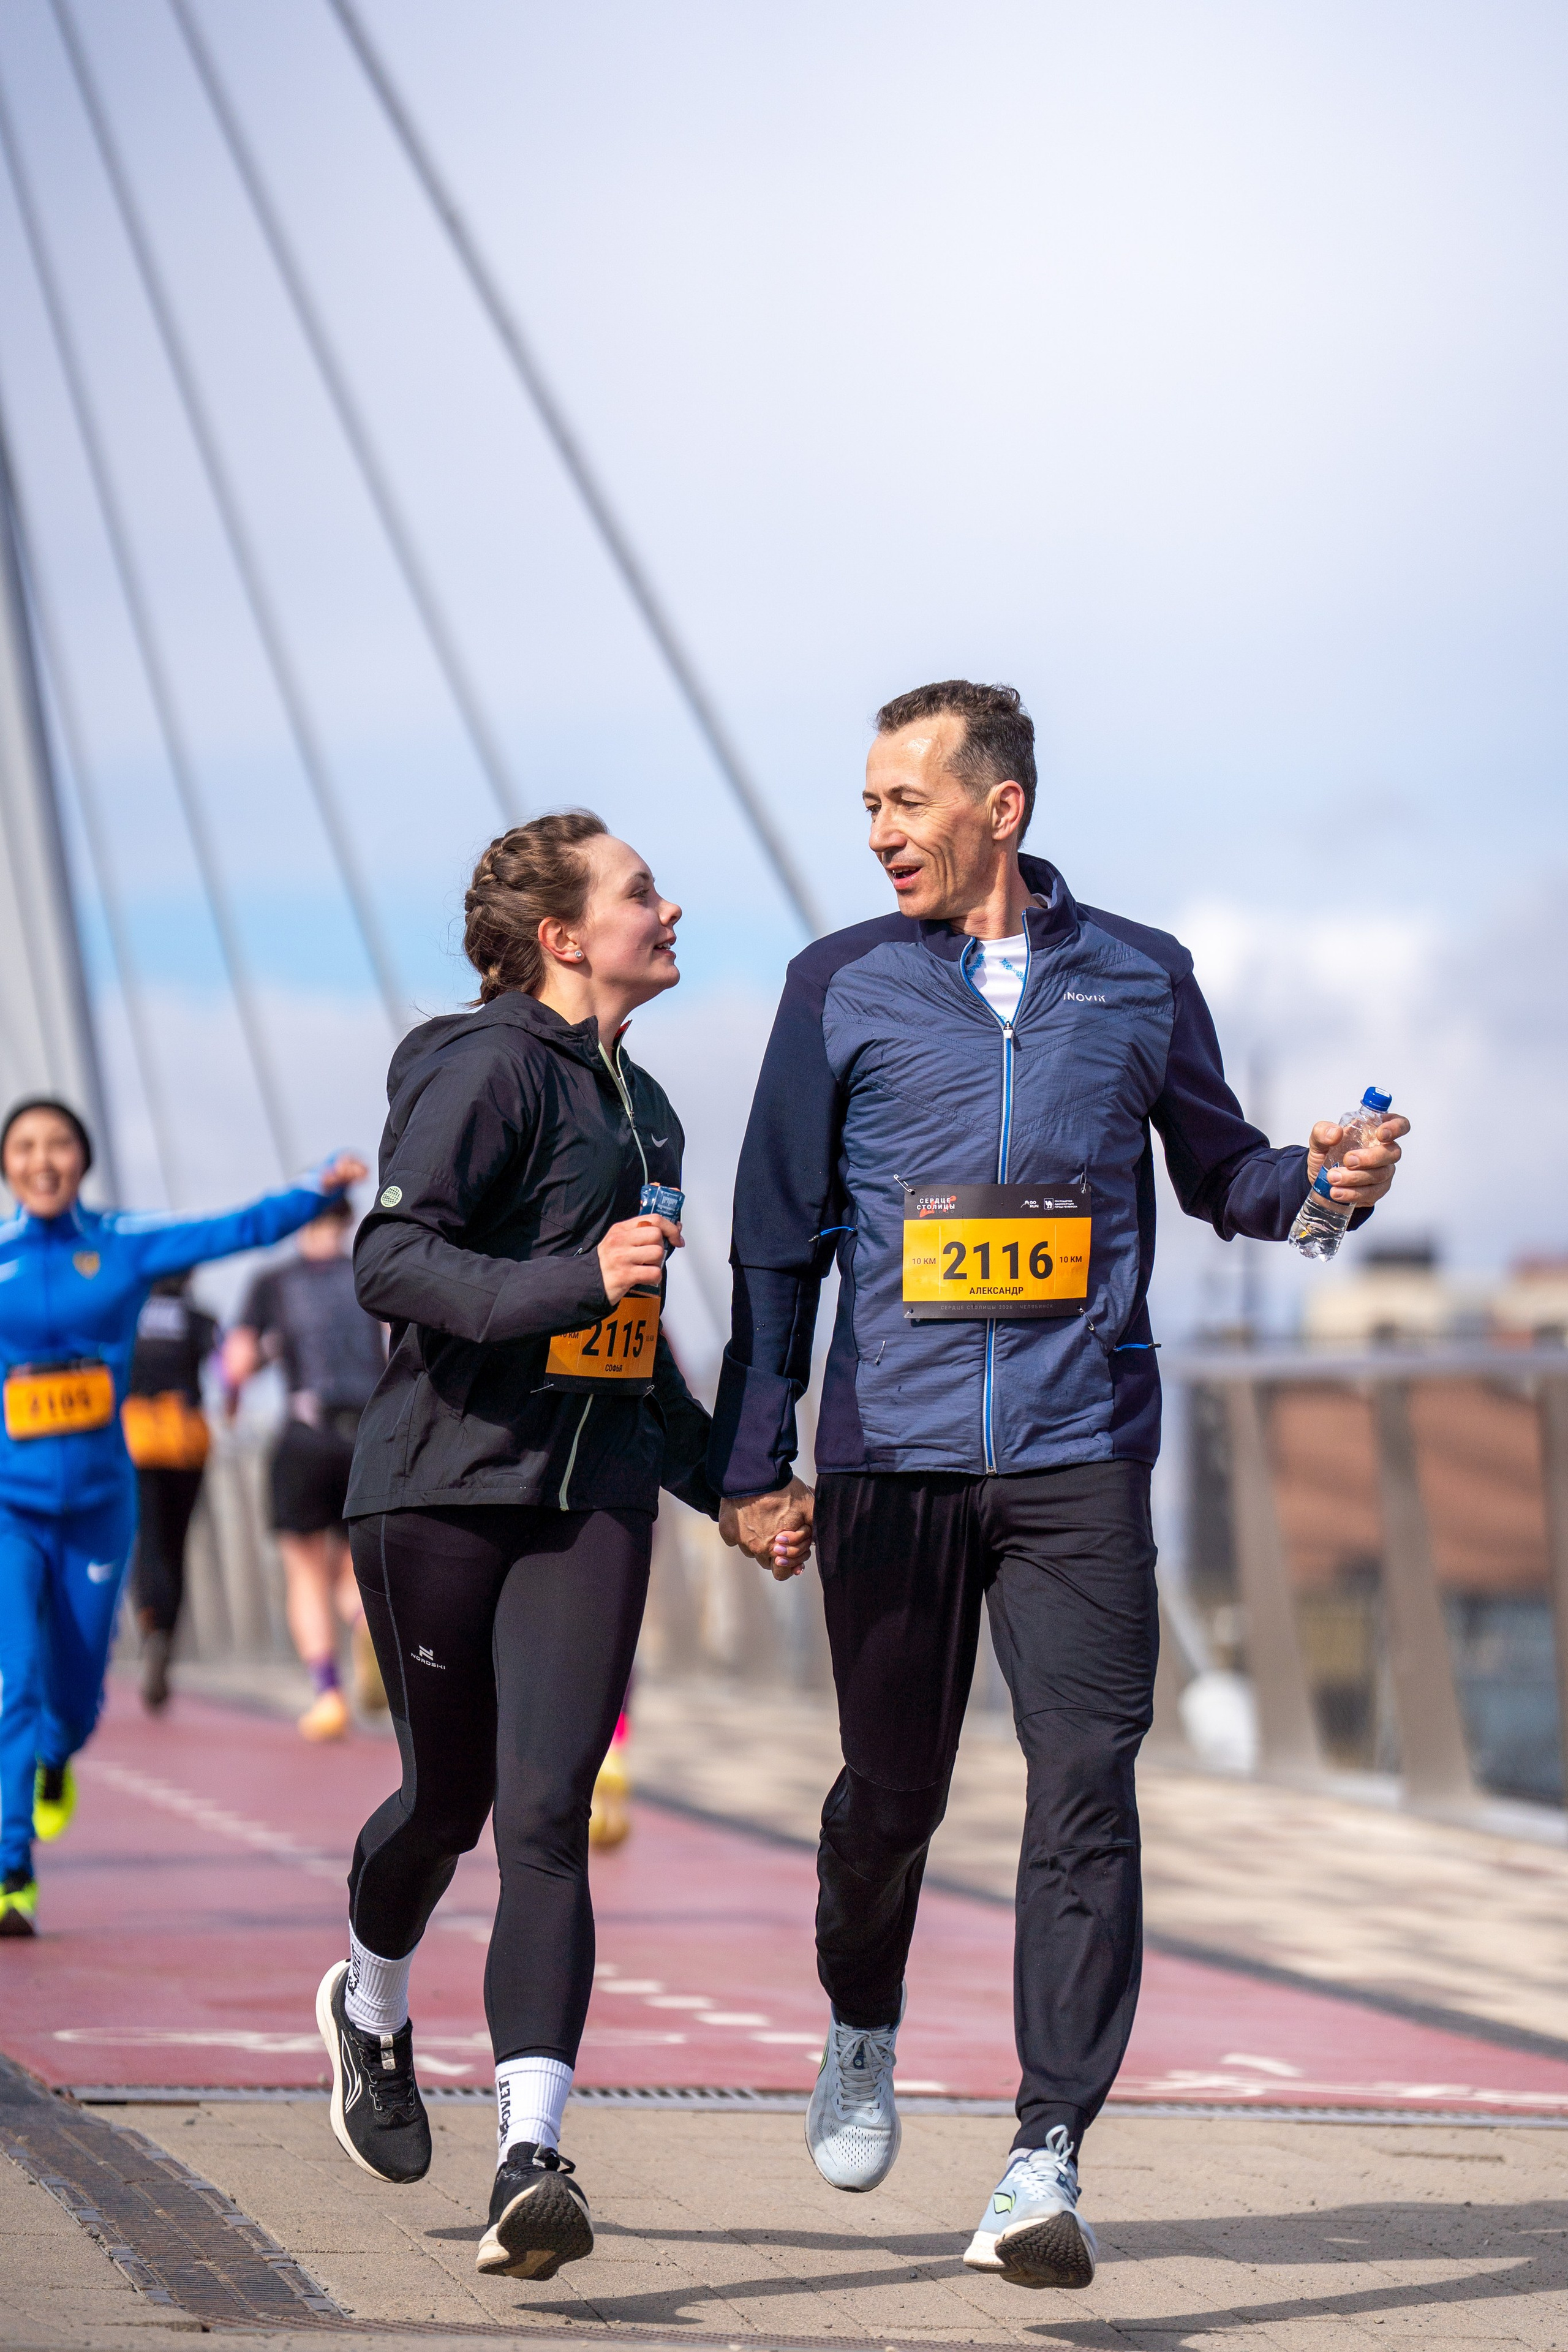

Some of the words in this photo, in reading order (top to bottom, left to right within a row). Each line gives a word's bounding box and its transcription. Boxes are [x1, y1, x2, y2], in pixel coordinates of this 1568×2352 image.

[942, 1241, 1053, 1280] 2116
[969, 1287, 1023, 1295] АЛЕКСАНДР
[581, 1319, 646, 1358] 2115
[410, 1653, 446, 1670] NORDSKI
